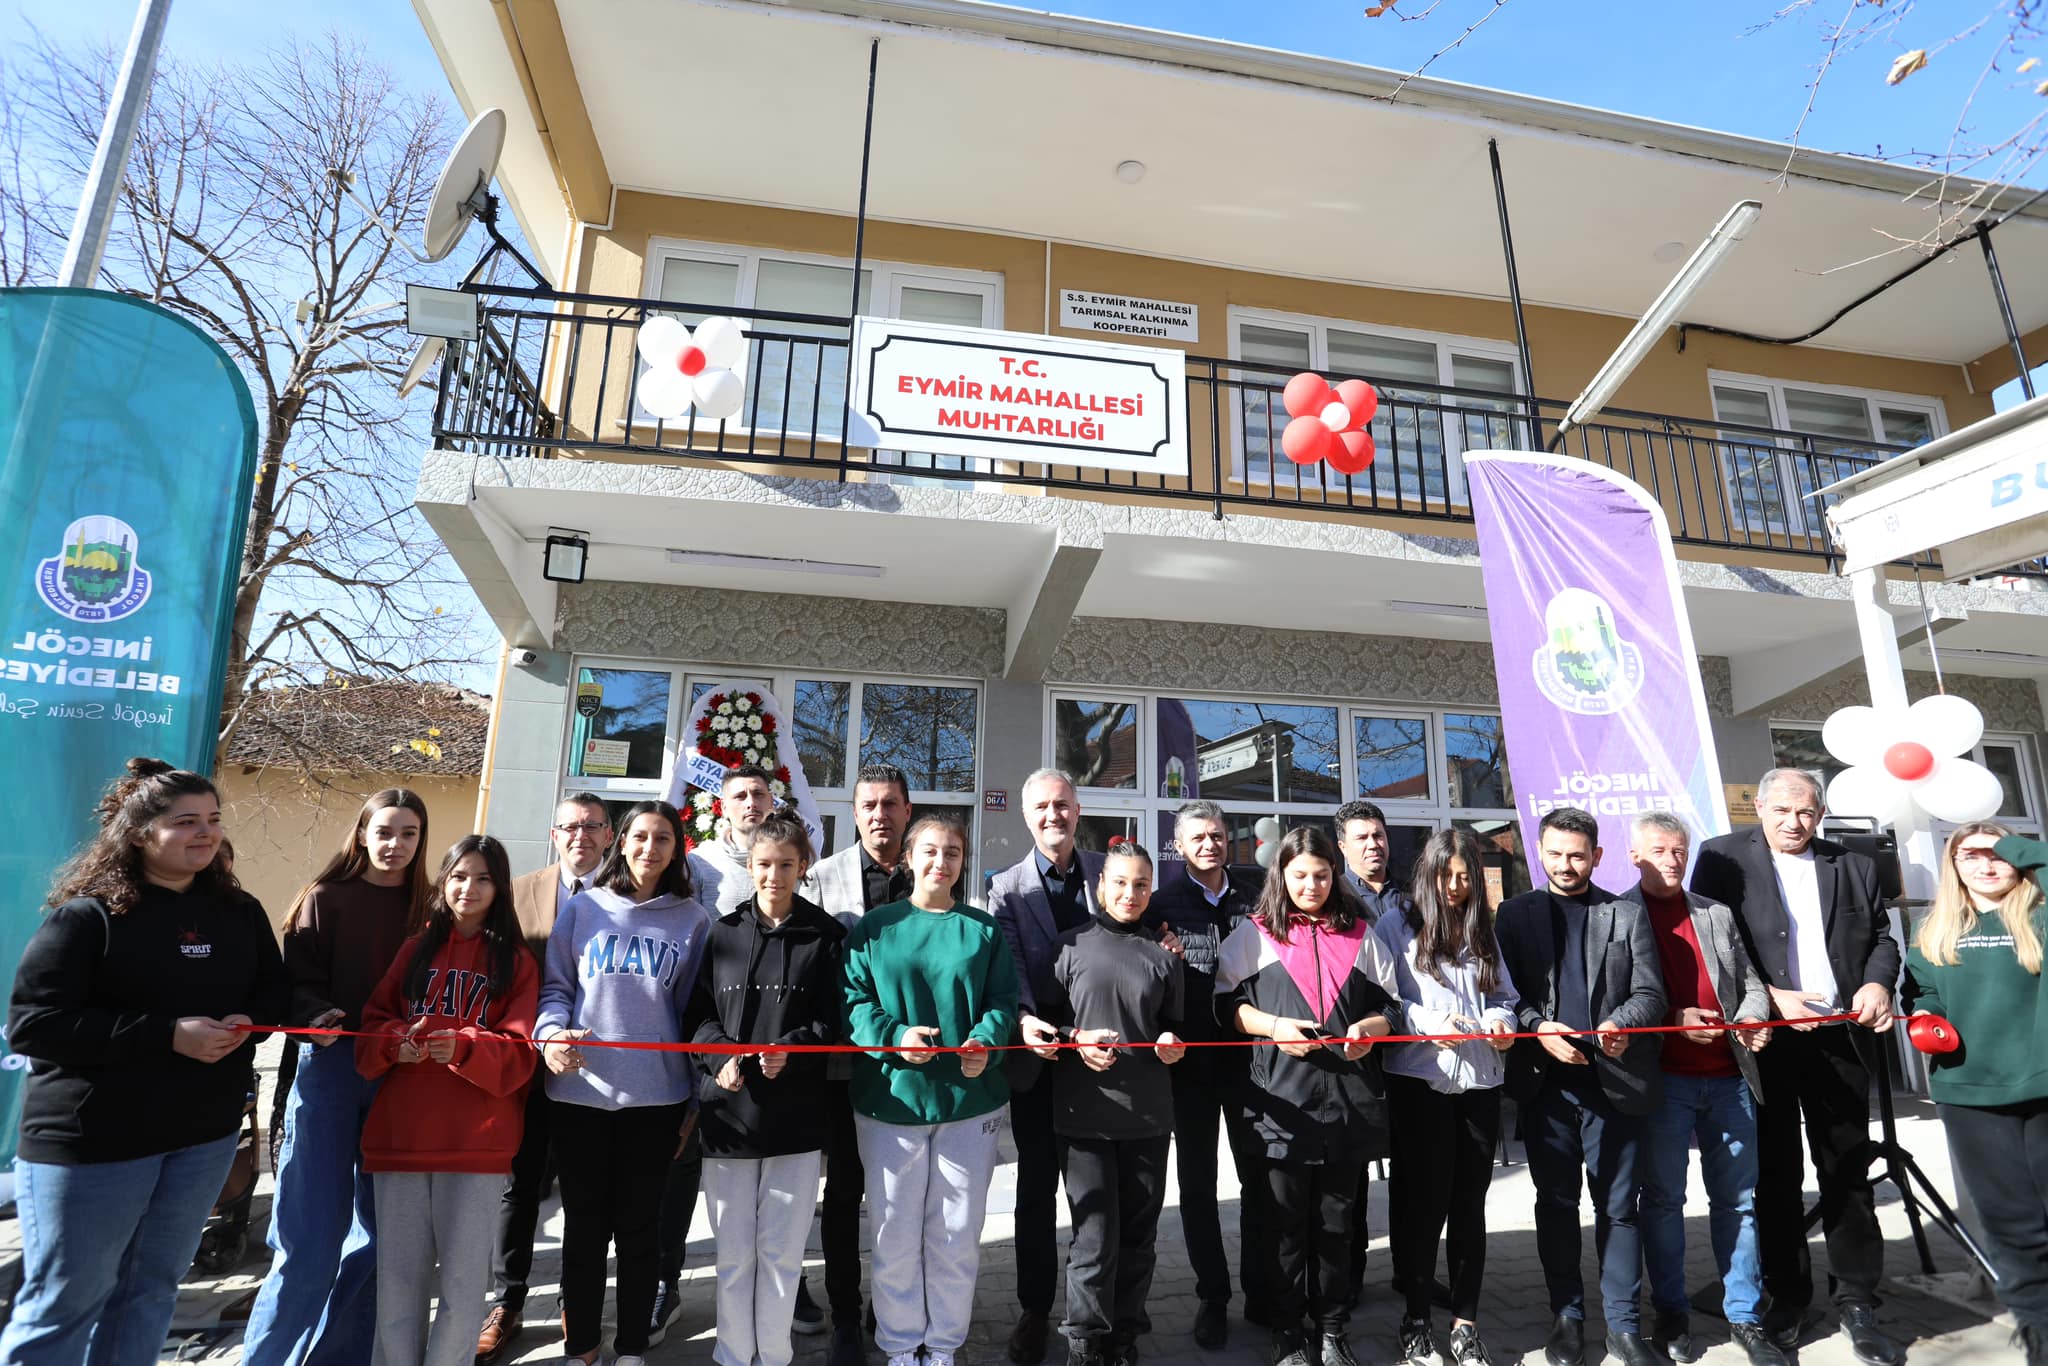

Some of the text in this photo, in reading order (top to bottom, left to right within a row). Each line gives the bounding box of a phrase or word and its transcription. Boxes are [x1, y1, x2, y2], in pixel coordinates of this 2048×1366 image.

[1066, 293, 1192, 315] S.S. EYMİR MAHALLESİ
[1070, 306, 1189, 327] TARIMSAL KALKINMA
[1093, 321, 1167, 337] KOOPERATİFİ
[998, 356, 1048, 379] T.C.
[897, 374, 1143, 417] EYMİR MAHALLESİ
[937, 408, 1104, 441] MUHTARLIĞI
[688, 757, 723, 780] BEYA
[692, 773, 723, 795] NES
